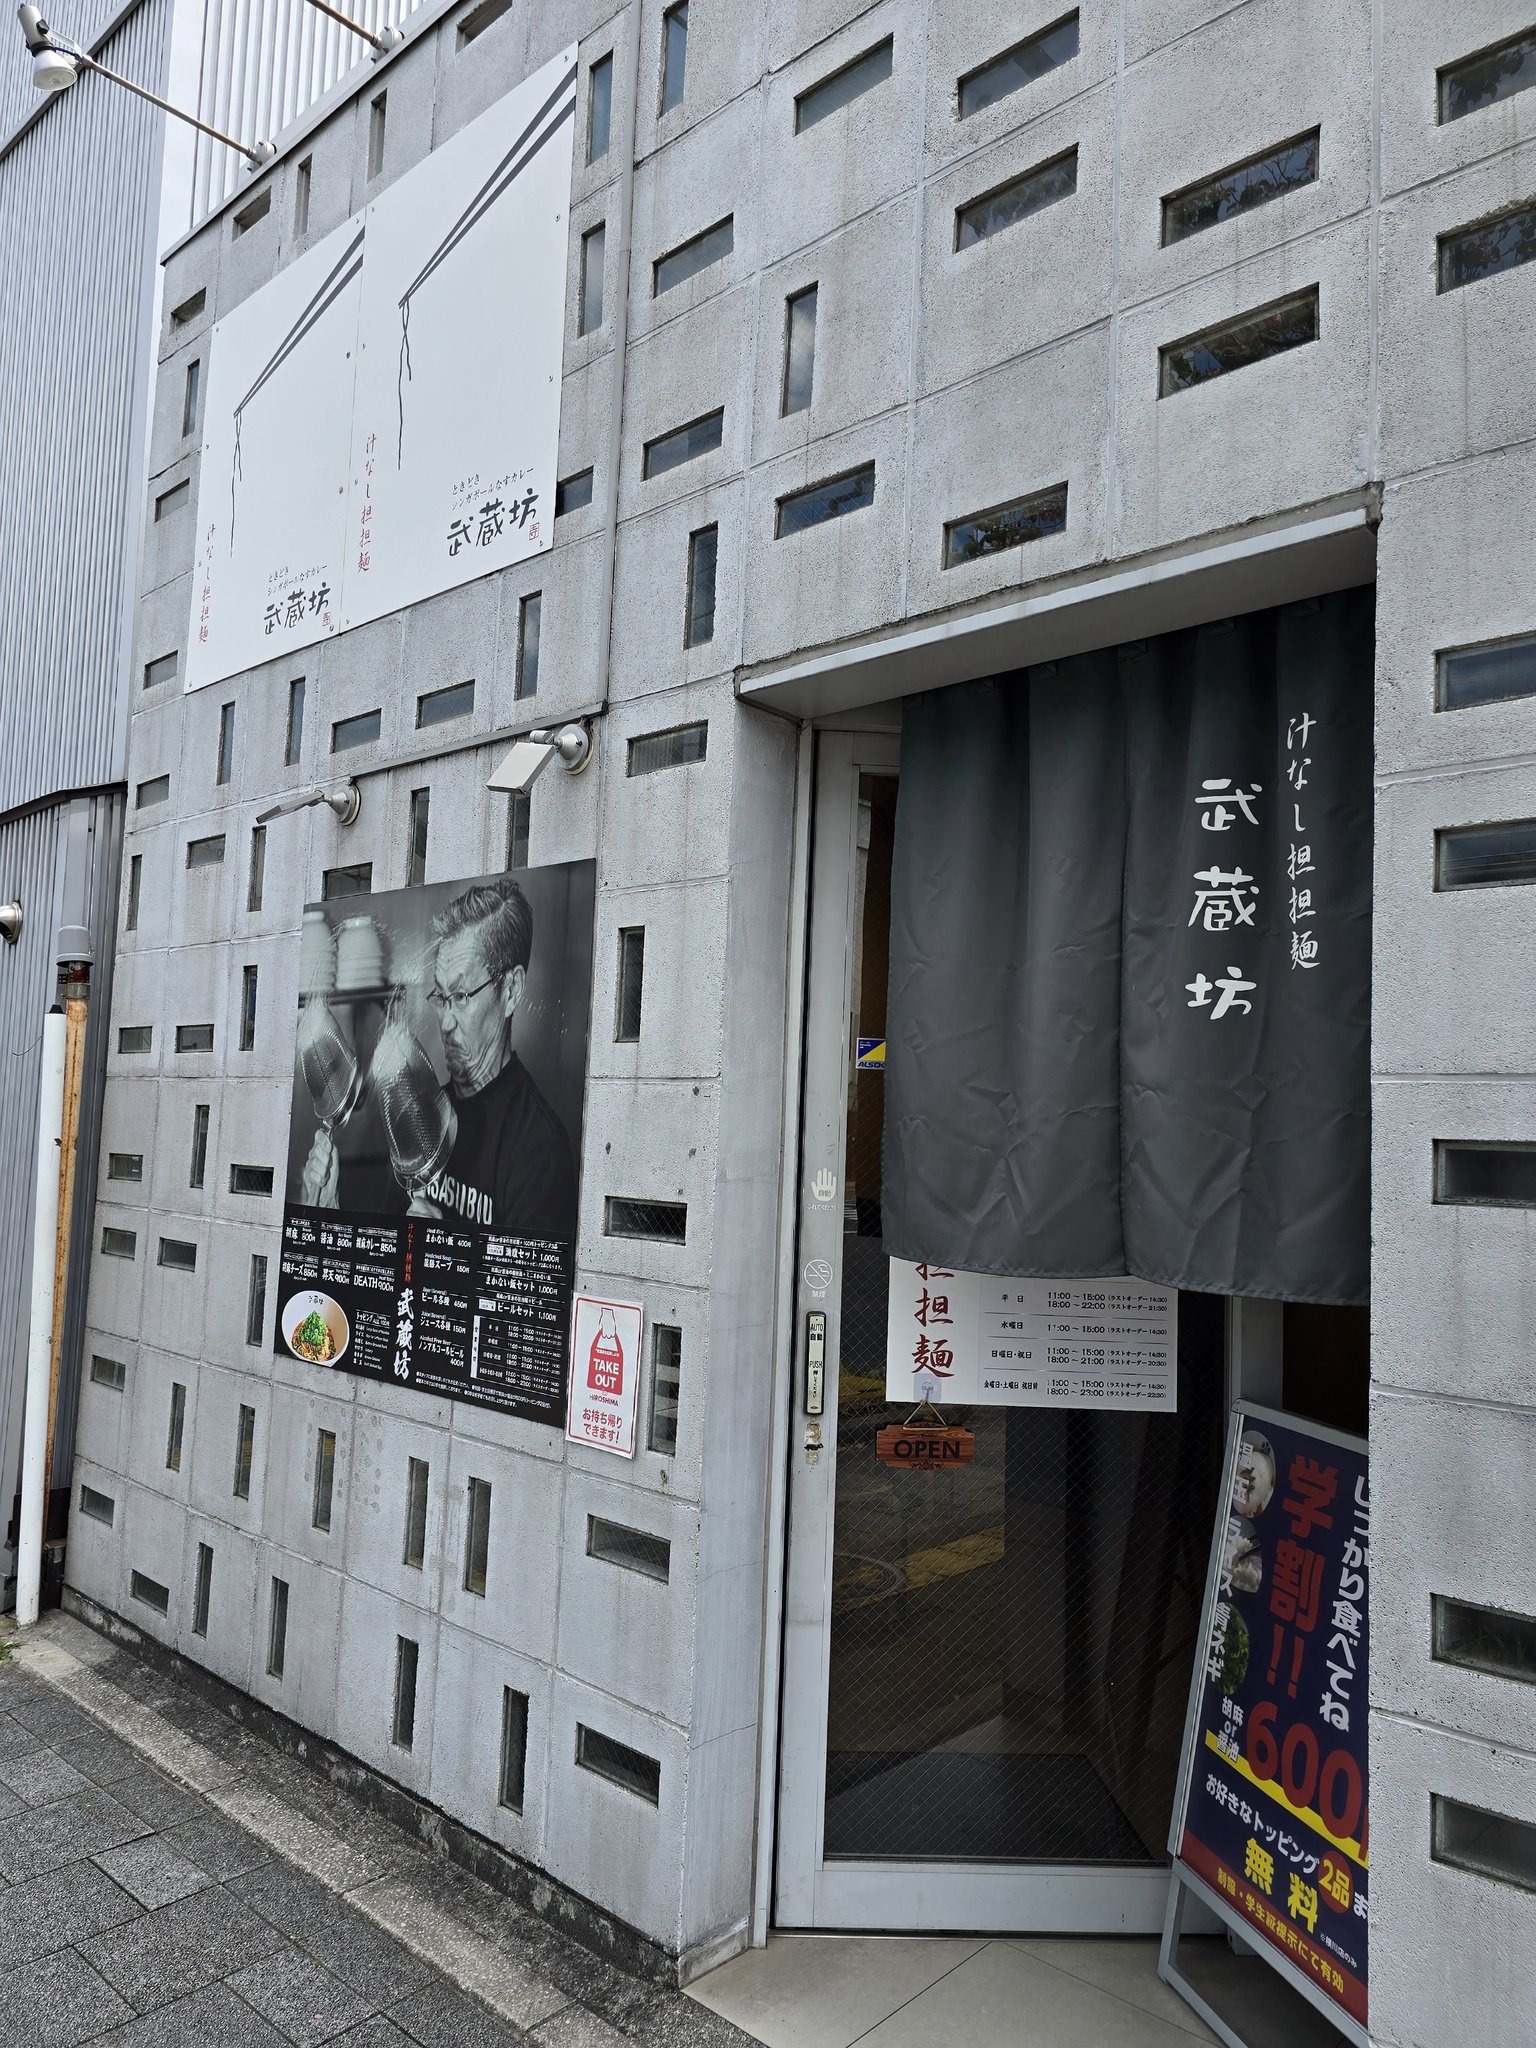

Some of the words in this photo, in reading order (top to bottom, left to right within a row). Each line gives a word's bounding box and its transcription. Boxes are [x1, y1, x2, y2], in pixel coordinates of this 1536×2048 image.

[452, 473, 480, 495] ときどき
[358, 433, 377, 574] 汁なし担担麺
[446, 487, 539, 557] 武蔵坊
[199, 523, 216, 643] 汁なし担担麺
[268, 566, 290, 583] ときどき
[263, 581, 331, 635] 武蔵坊
[1286, 712, 1320, 970] 汁なし担担麺
[1185, 778, 1263, 1020] 武蔵坊
[425, 1233, 454, 1246] まかない飯
[457, 1239, 472, 1248] 400円
[540, 1253, 560, 1263] 1,000円
[353, 1274, 378, 1289] DEATH
[485, 1274, 536, 1292] まかない飯セット
[538, 1285, 558, 1296] 1,000円
[421, 1292, 450, 1307] ビール各種
[497, 1301, 534, 1318] ビールセット
[394, 1288, 415, 1381] 武蔵坊
[419, 1316, 451, 1332] ジュース各種
[453, 1324, 467, 1334] 150円
[810, 1323, 823, 1332] AUTO
[1000, 1321, 1024, 1330] 水曜日
[810, 1333, 823, 1341] 自動
[418, 1341, 465, 1360] ノンアルコールビール
[991, 1349, 1032, 1359] 日曜日・祝日
[449, 1357, 465, 1368] 400円
[592, 1358, 620, 1376] TAKE
[809, 1360, 822, 1369] PUSH
[594, 1374, 618, 1390] OUT
[589, 1393, 619, 1407] HIROSHIMA
[582, 1407, 623, 1430] お持ち帰り
[583, 1423, 621, 1444] できます!
[893, 1439, 960, 1459] OPEN
[1266, 1454, 1340, 1699] 学割!!
[1206, 1601, 1231, 1683] 青ネギ
[1221, 1696, 1244, 1727] 胡麻
[1223, 1720, 1238, 1737] or
[1215, 1730, 1240, 1764] 醤油
[1246, 1700, 1370, 1858] 600
[1244, 1837, 1318, 1934] 無料
[1217, 1866, 1344, 1994] 制服・学生証提示にて有効
